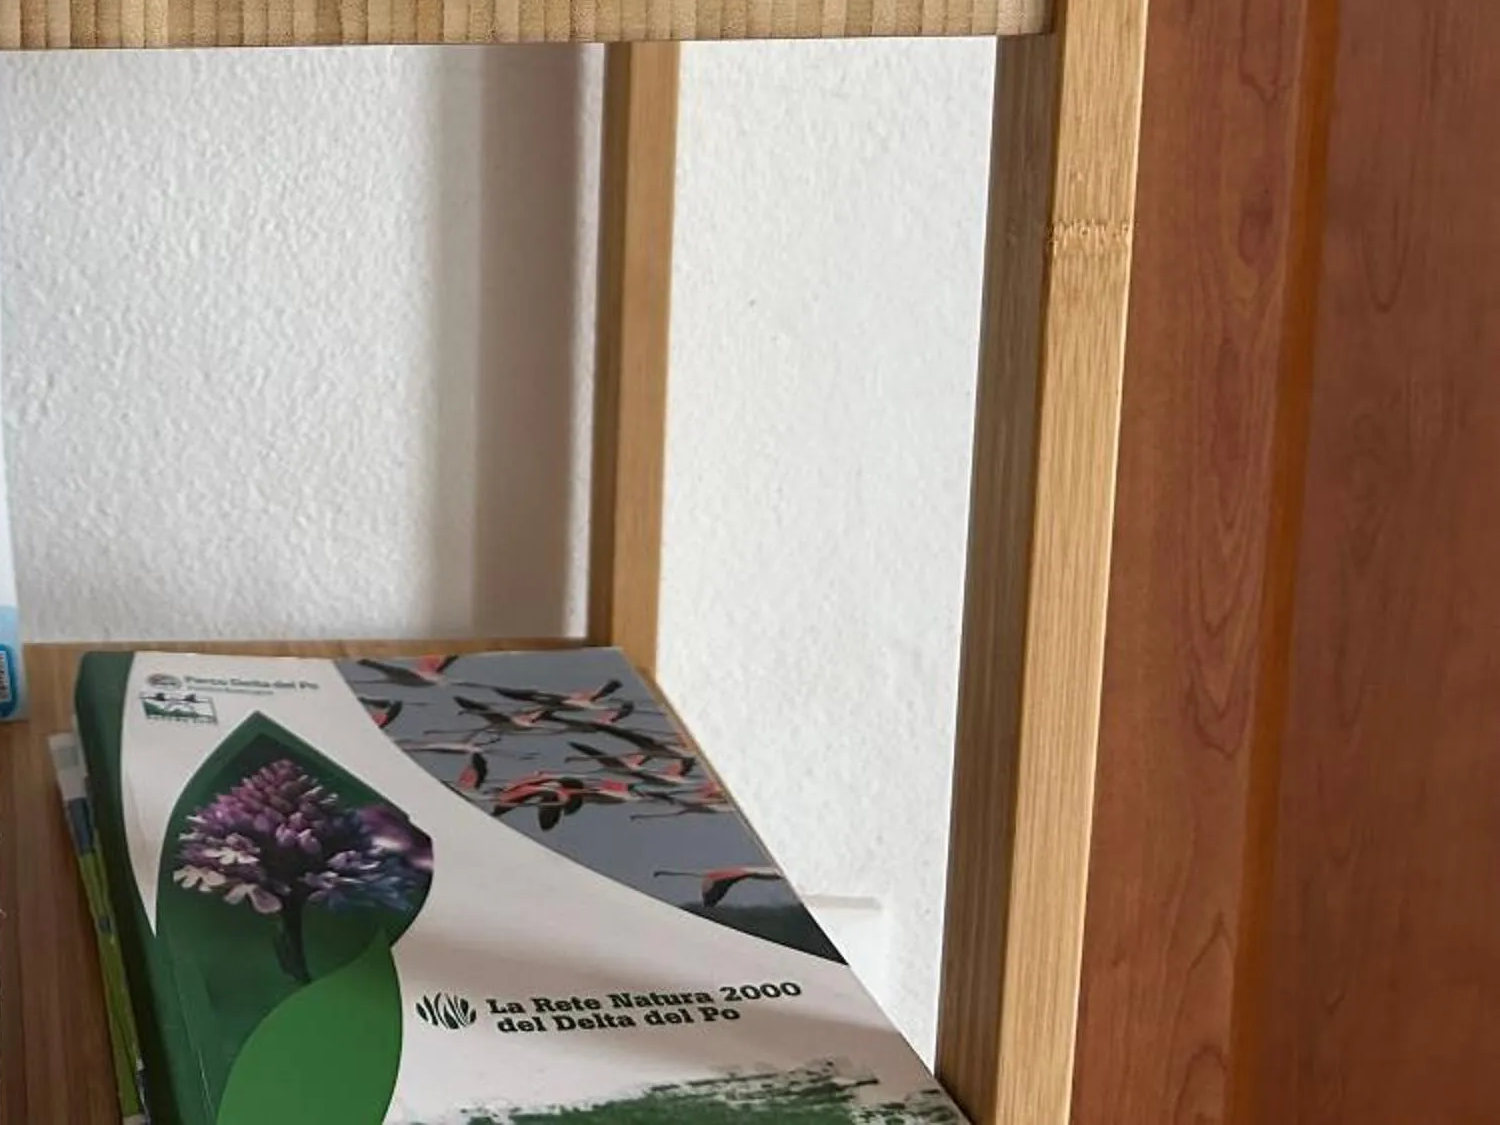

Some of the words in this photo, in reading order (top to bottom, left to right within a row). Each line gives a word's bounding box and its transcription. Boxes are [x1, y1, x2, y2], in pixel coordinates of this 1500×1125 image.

[487, 998, 524, 1015] La
[531, 994, 601, 1015] Rete
[607, 988, 714, 1010] Natura
[719, 981, 803, 1003] 2000
[496, 1015, 549, 1035] del
[555, 1011, 637, 1032] Delta
[644, 1008, 692, 1027] del
[699, 1004, 741, 1023] Po
